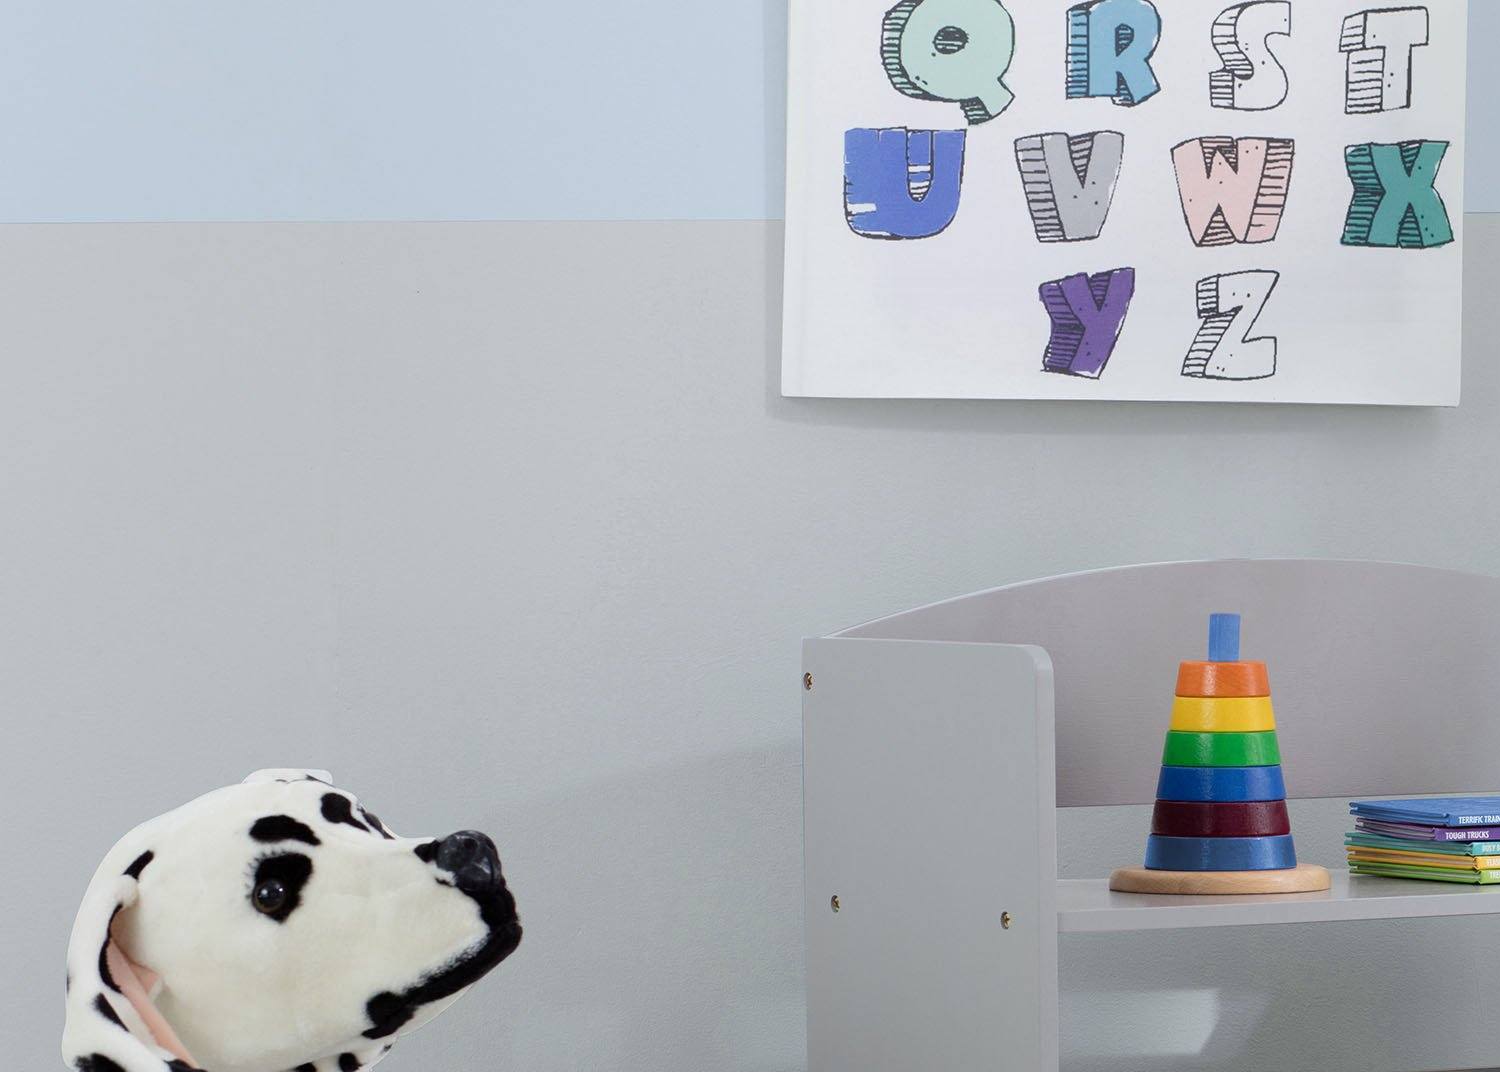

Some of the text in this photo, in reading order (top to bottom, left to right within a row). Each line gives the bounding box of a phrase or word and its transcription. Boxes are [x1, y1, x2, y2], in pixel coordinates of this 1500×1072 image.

[880, 0, 1429, 125] Q R S T
[844, 126, 1454, 249] U V W X
[1039, 267, 1280, 380] Y Z
[1446, 830, 1490, 840] TOUGH TRUCKS
[1458, 815, 1483, 824] TERRIFIC
